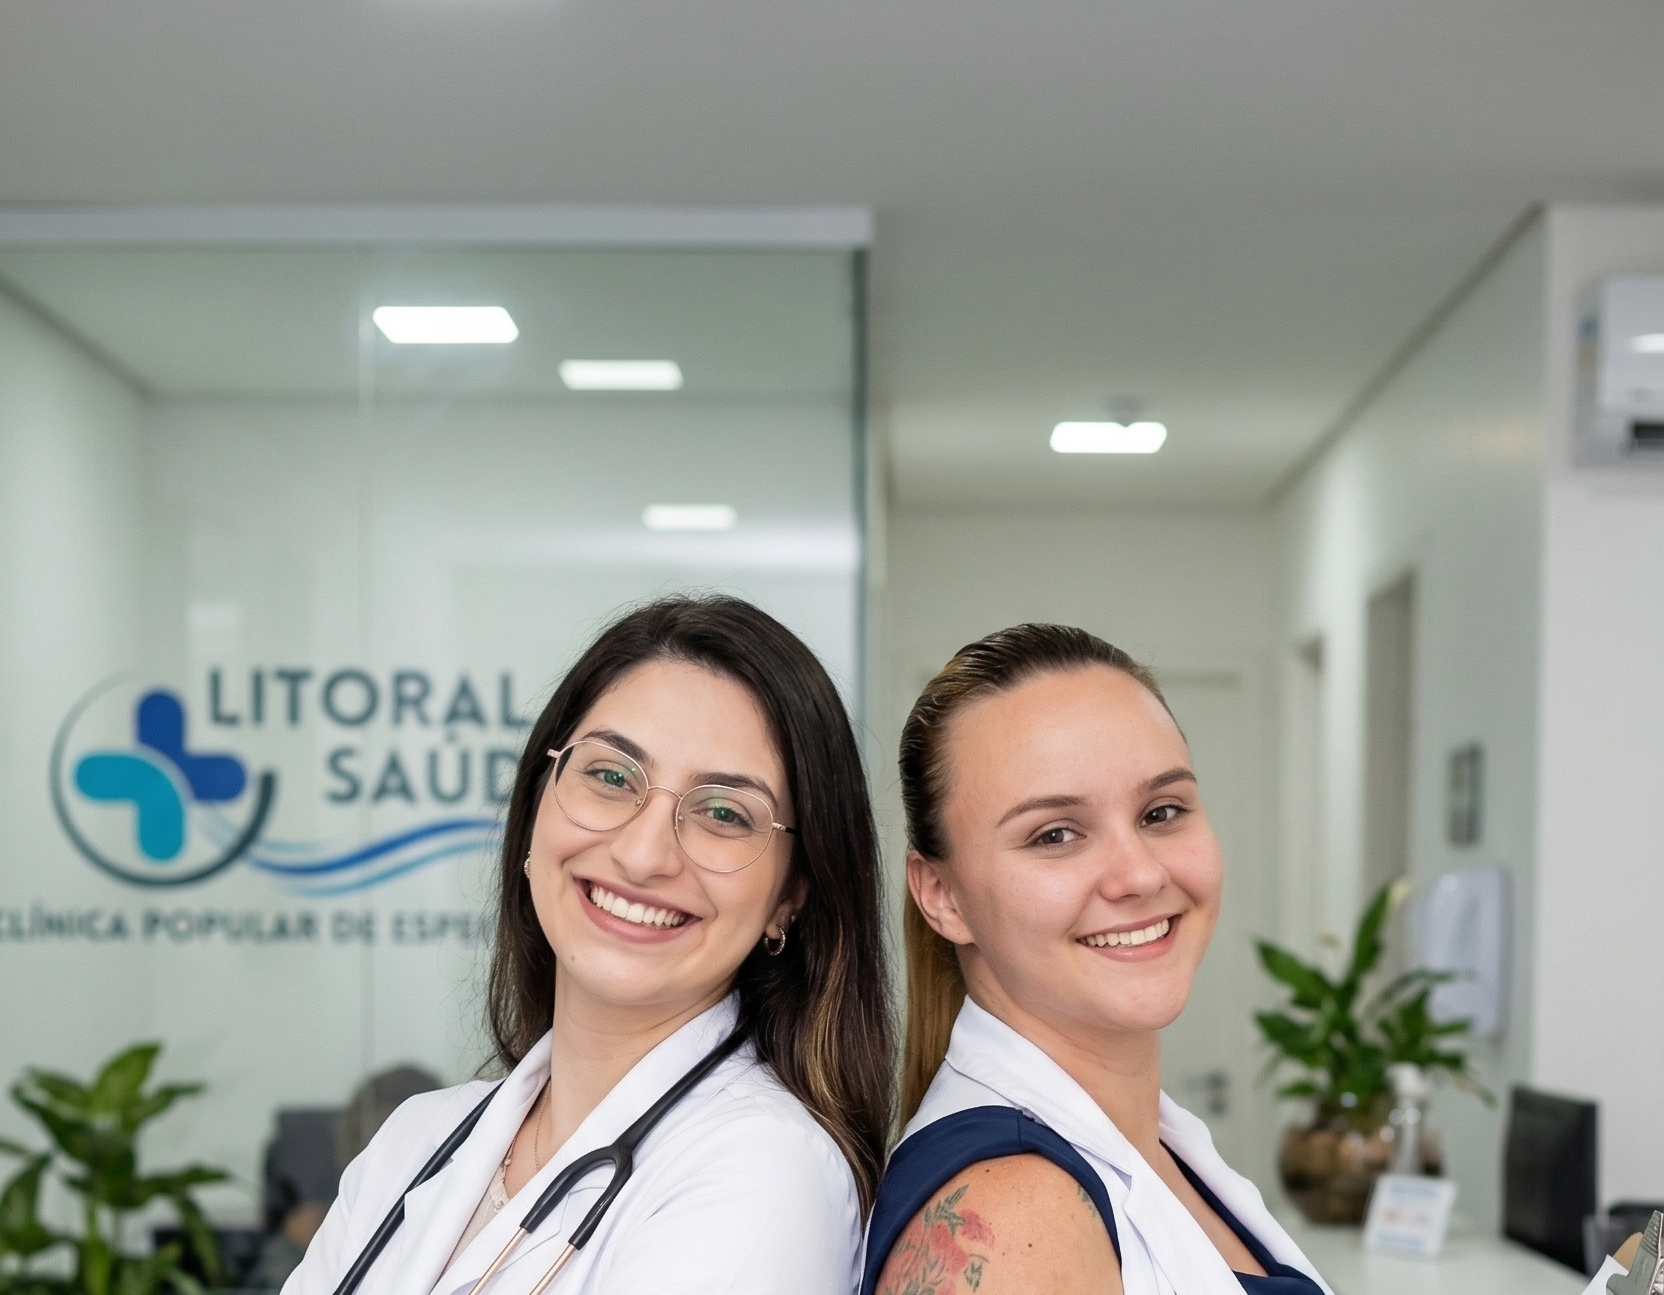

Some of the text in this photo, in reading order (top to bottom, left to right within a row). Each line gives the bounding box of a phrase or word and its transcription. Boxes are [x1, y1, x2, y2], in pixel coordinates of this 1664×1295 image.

[208, 667, 534, 728] LITORAL
[142, 910, 317, 944] POPULAR
[330, 910, 376, 944] DE
[391, 910, 486, 944] ESPE
